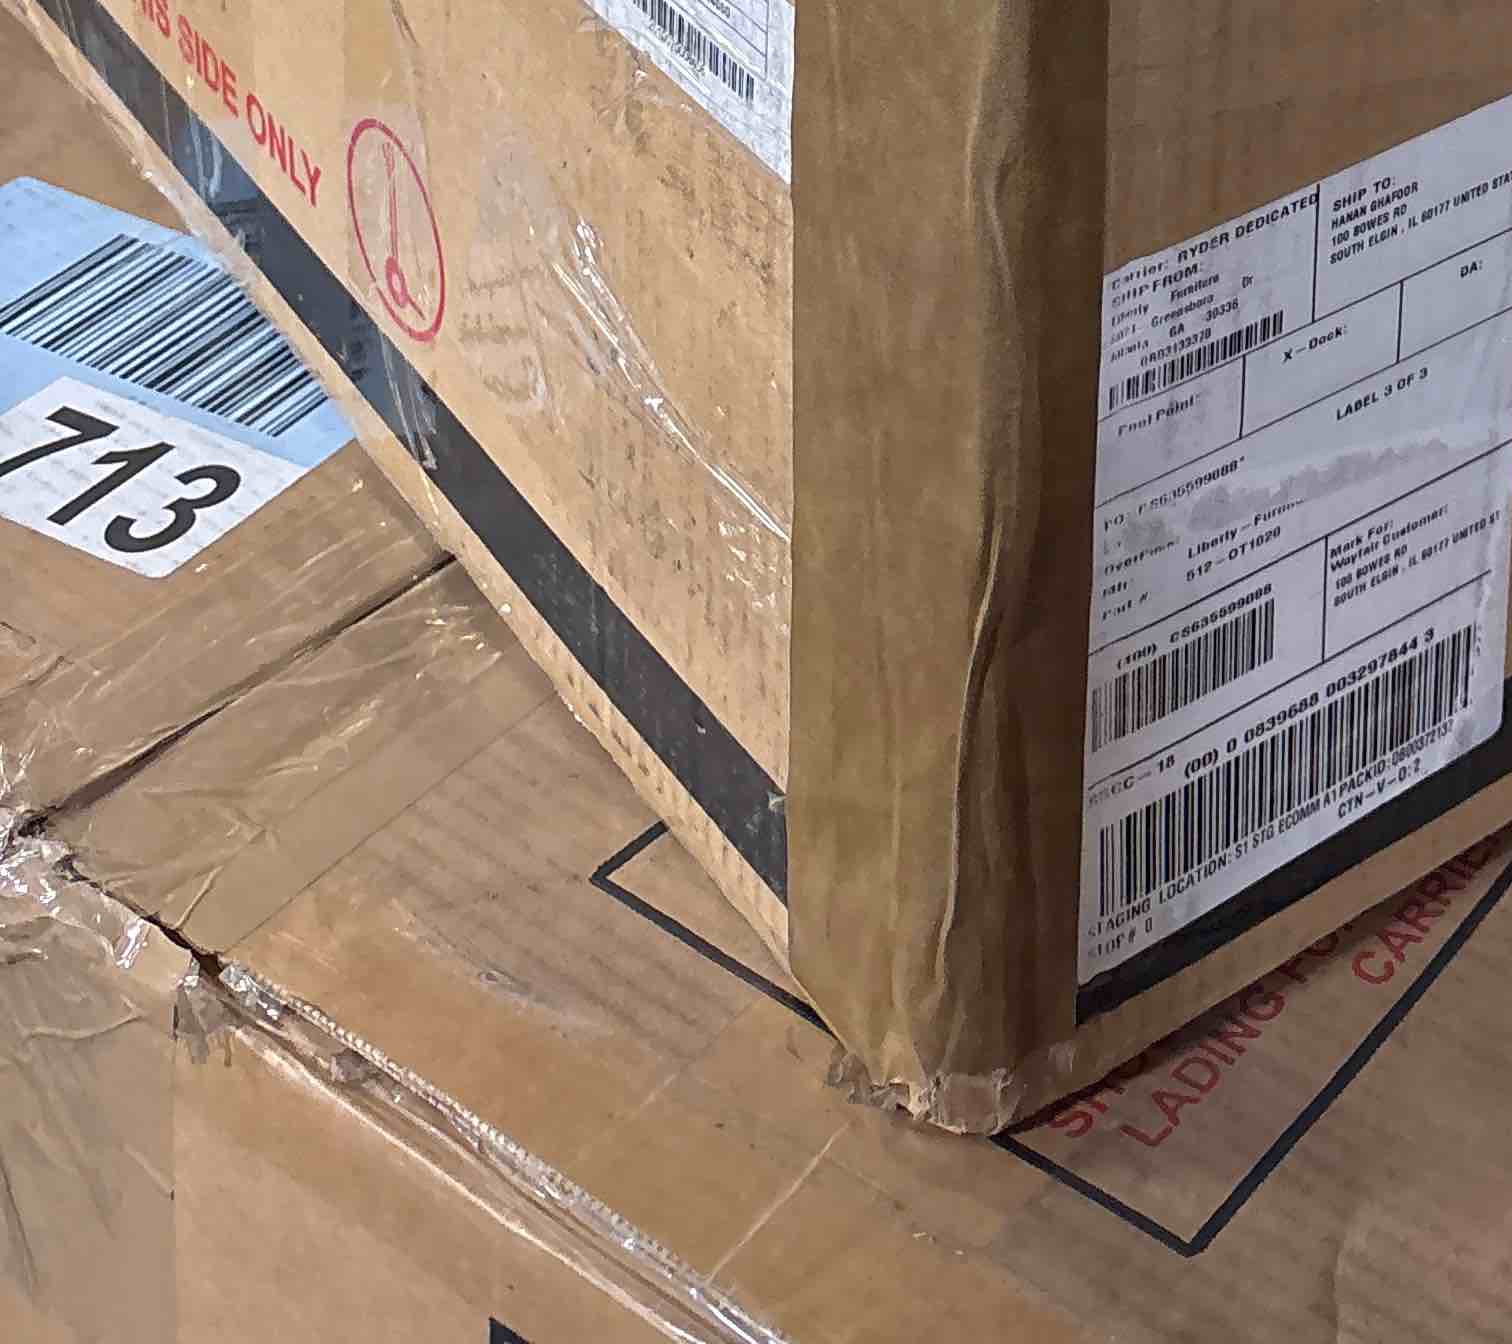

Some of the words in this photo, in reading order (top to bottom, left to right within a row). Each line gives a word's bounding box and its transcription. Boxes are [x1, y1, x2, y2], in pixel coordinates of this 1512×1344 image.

[177, 14, 240, 118] SIDE
[246, 92, 322, 209] ONLY
[1330, 203, 1366, 231] HANAN
[1370, 179, 1418, 212] GHAFOOR
[1332, 186, 1367, 213] SHIP
[1373, 173, 1396, 195] TO:
[1392, 202, 1408, 220] RD
[1178, 229, 1229, 265] RYDER
[1235, 190, 1318, 239] DEDICATED
[1329, 238, 1364, 265] SOUTH
[1368, 222, 1398, 247] ELGIN
[1407, 213, 1418, 229] IL
[1453, 181, 1488, 208] UNITED
[1459, 257, 1483, 279] DA:
[1336, 387, 1379, 422] LABEL
[1384, 382, 1392, 398] 3
[1396, 371, 1415, 392] OF
[1419, 365, 1428, 381] 3
[0, 405, 242, 554] 713
[1329, 531, 1363, 562] Mark
[1330, 539, 1378, 575] Wayfair
[1184, 744, 1219, 783] (00)
[1225, 735, 1237, 756] 0
[1423, 623, 1435, 645] 3
[1159, 846, 1231, 907] LOCATION:
[1278, 796, 1320, 837] ECOMM
